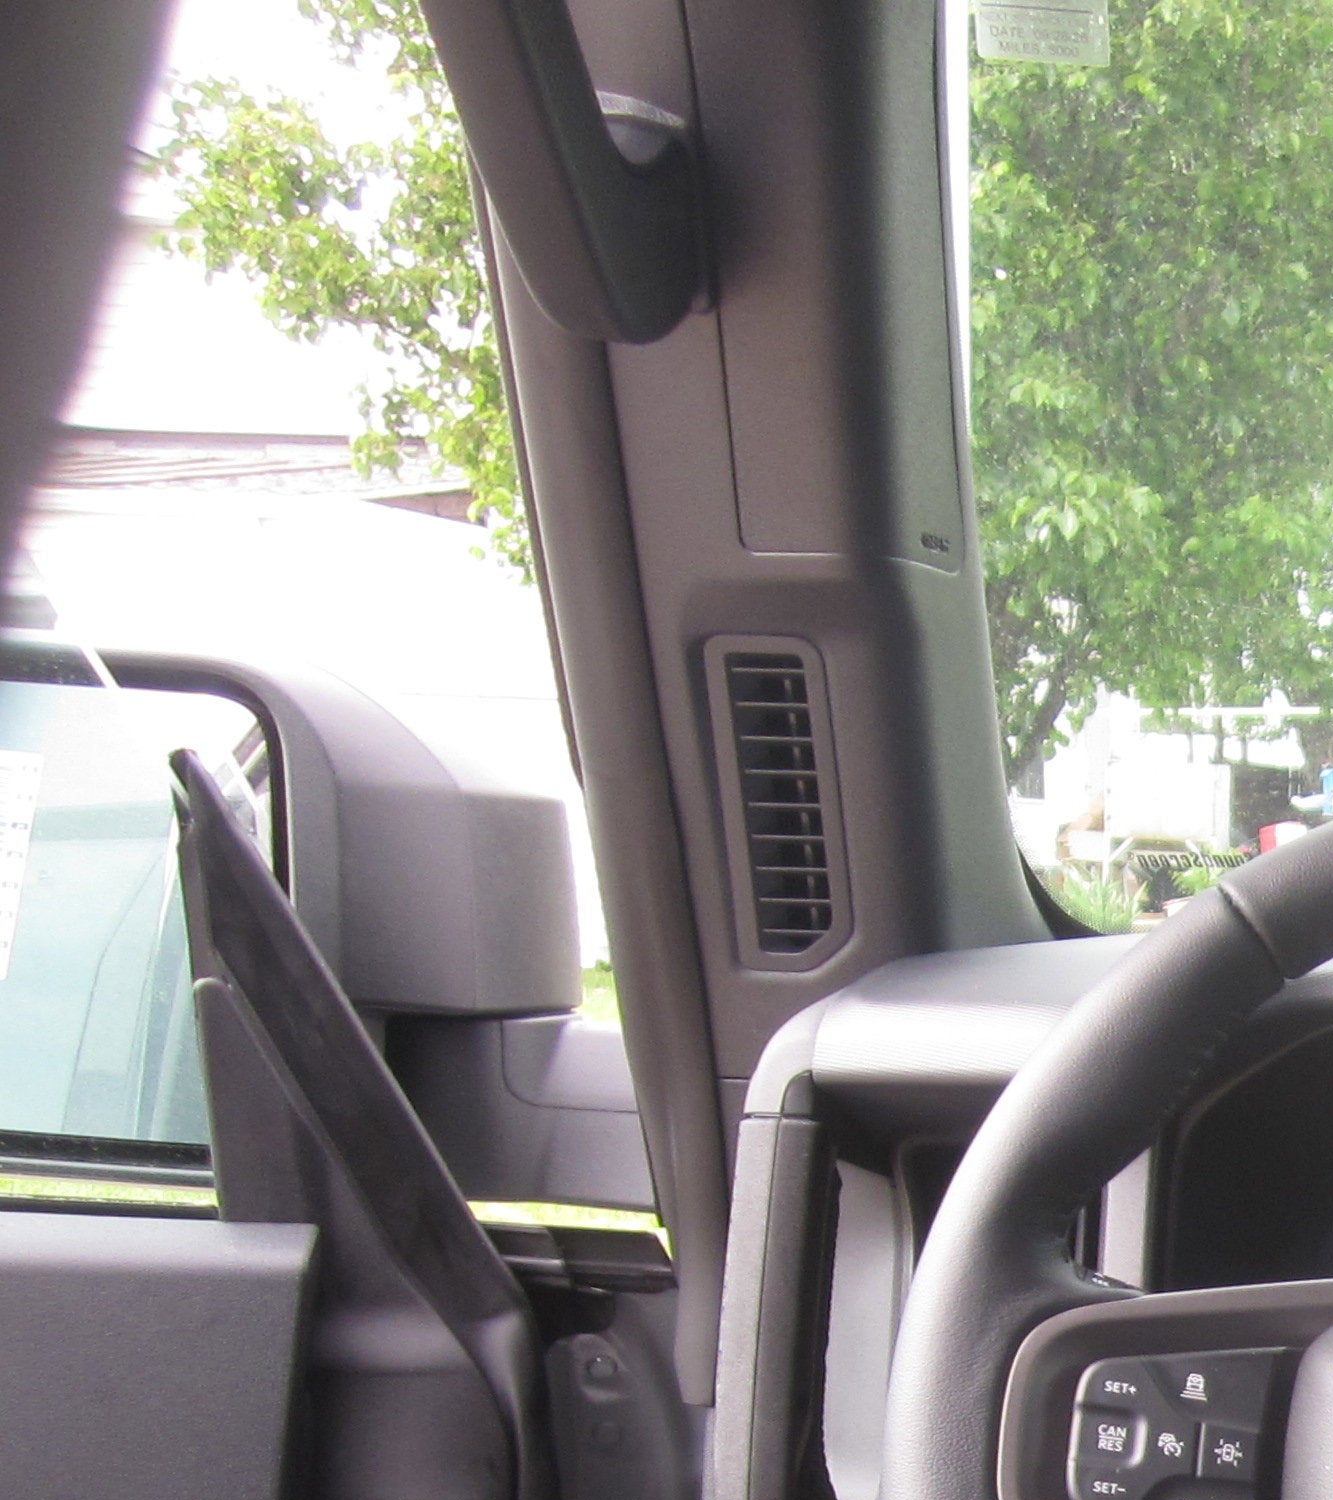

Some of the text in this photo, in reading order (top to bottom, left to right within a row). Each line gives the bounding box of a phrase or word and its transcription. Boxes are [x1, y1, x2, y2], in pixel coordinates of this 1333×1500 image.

[1105, 1380, 1137, 1395] SET+
[1098, 1424, 1127, 1438] CAN
[1097, 1438, 1123, 1452] RES
